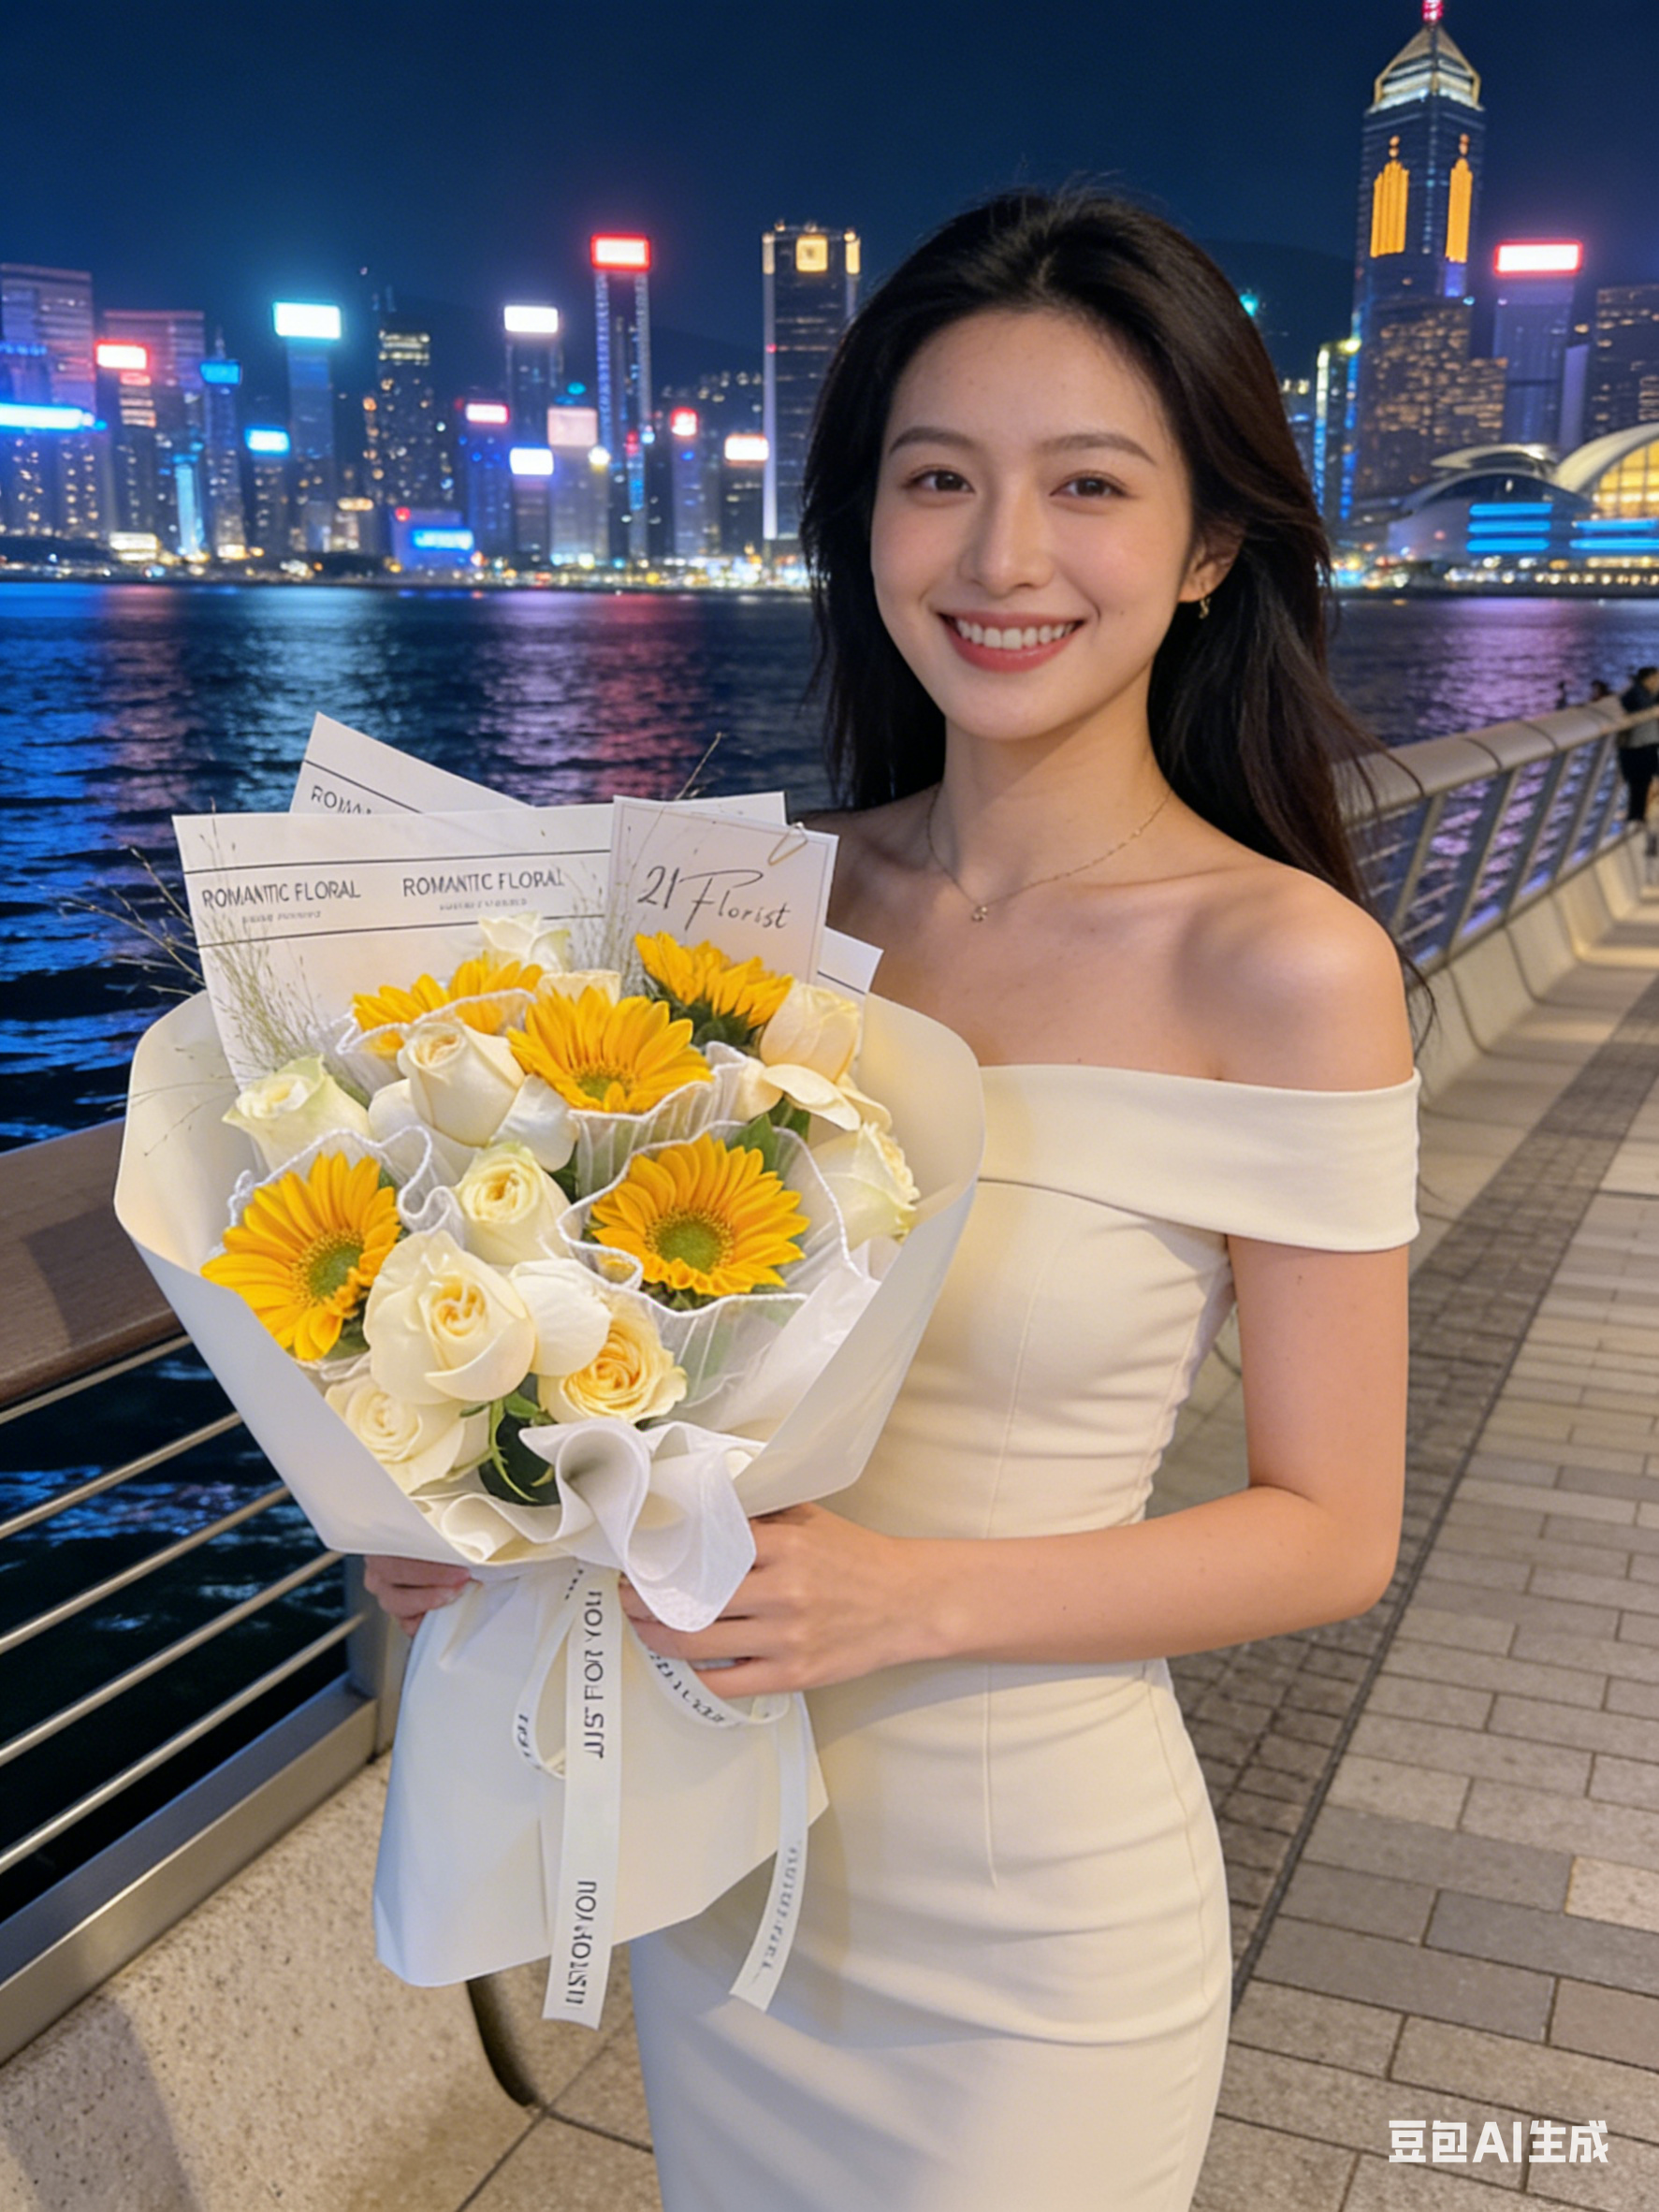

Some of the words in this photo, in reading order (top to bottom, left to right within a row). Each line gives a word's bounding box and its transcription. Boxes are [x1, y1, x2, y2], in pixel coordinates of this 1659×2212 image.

[311, 784, 371, 814] ROMA
[201, 883, 290, 909] ROMANTIC
[295, 880, 361, 902] FLORAL
[402, 872, 494, 897] ROMANTIC
[499, 867, 565, 890] FLORAL
[637, 865, 680, 910] 21
[678, 869, 792, 931] Florist
